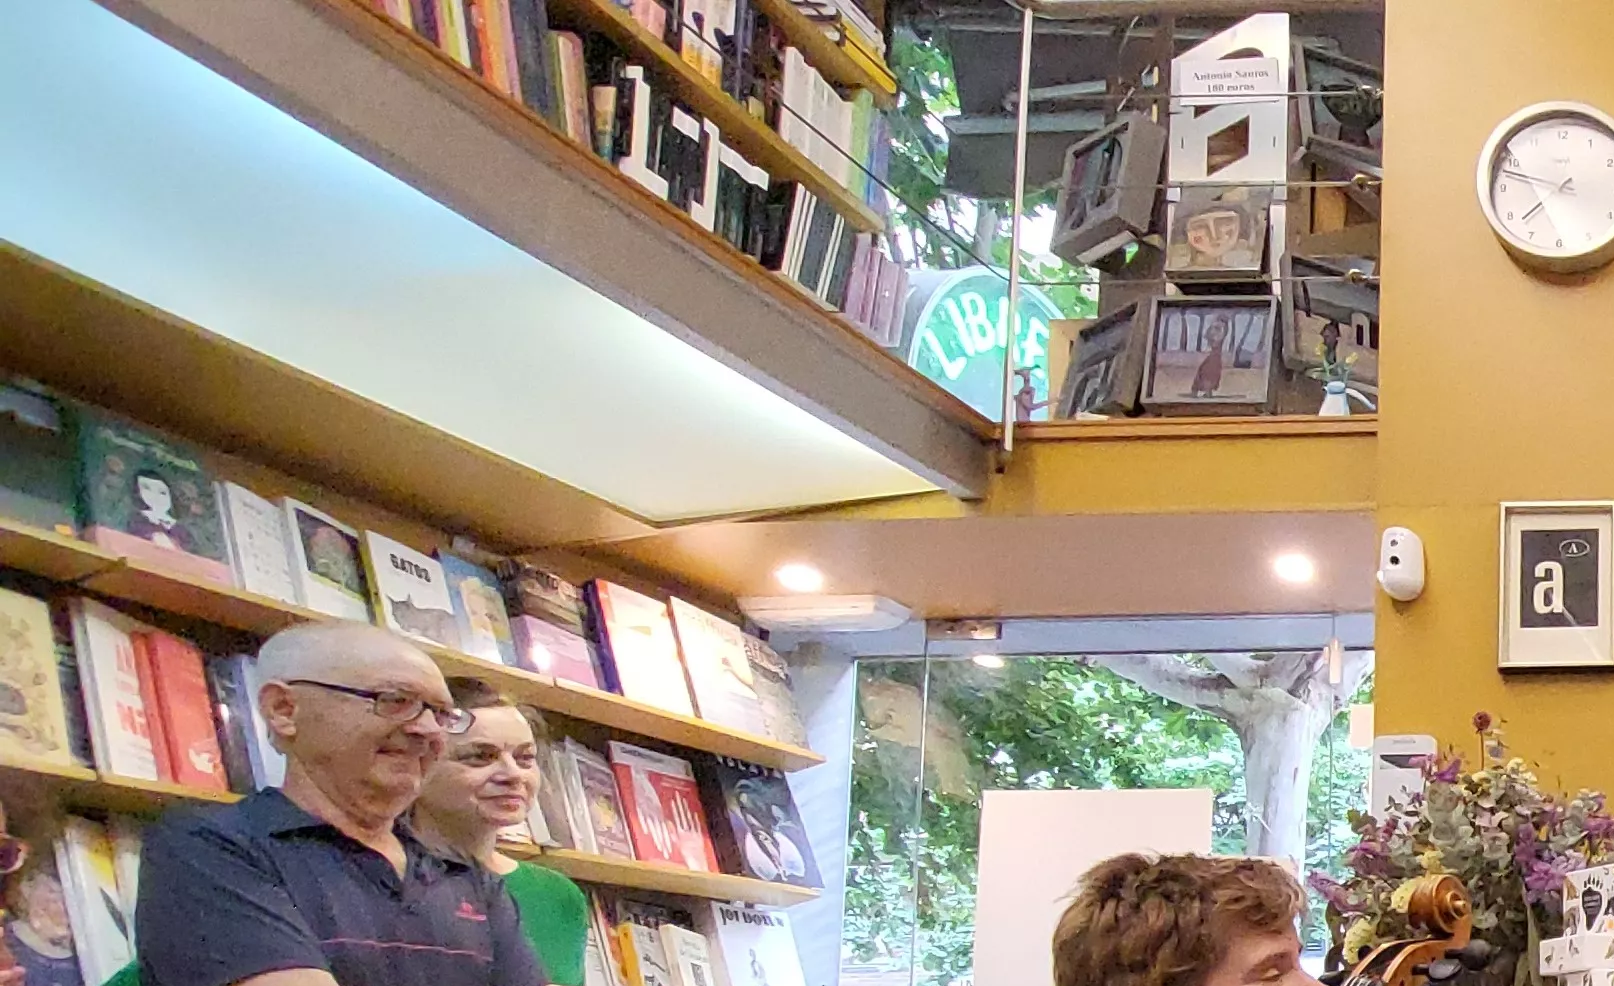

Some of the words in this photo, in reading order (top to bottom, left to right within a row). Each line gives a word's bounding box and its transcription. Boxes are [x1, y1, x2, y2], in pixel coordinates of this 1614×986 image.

[1193, 71, 1232, 81] Antonio
[1557, 130, 1569, 140] 12
[1587, 138, 1593, 148] 1
[1508, 158, 1520, 168] 10
[1606, 158, 1614, 168] 2
[1500, 183, 1507, 193] 9
[1507, 211, 1514, 221] 8
[1607, 211, 1613, 220] 4
[1528, 231, 1535, 240] 7
[1585, 232, 1592, 242] 5
[1555, 238, 1563, 248] 6
[389, 553, 431, 583] GATOS
[1533, 561, 1564, 614] a
